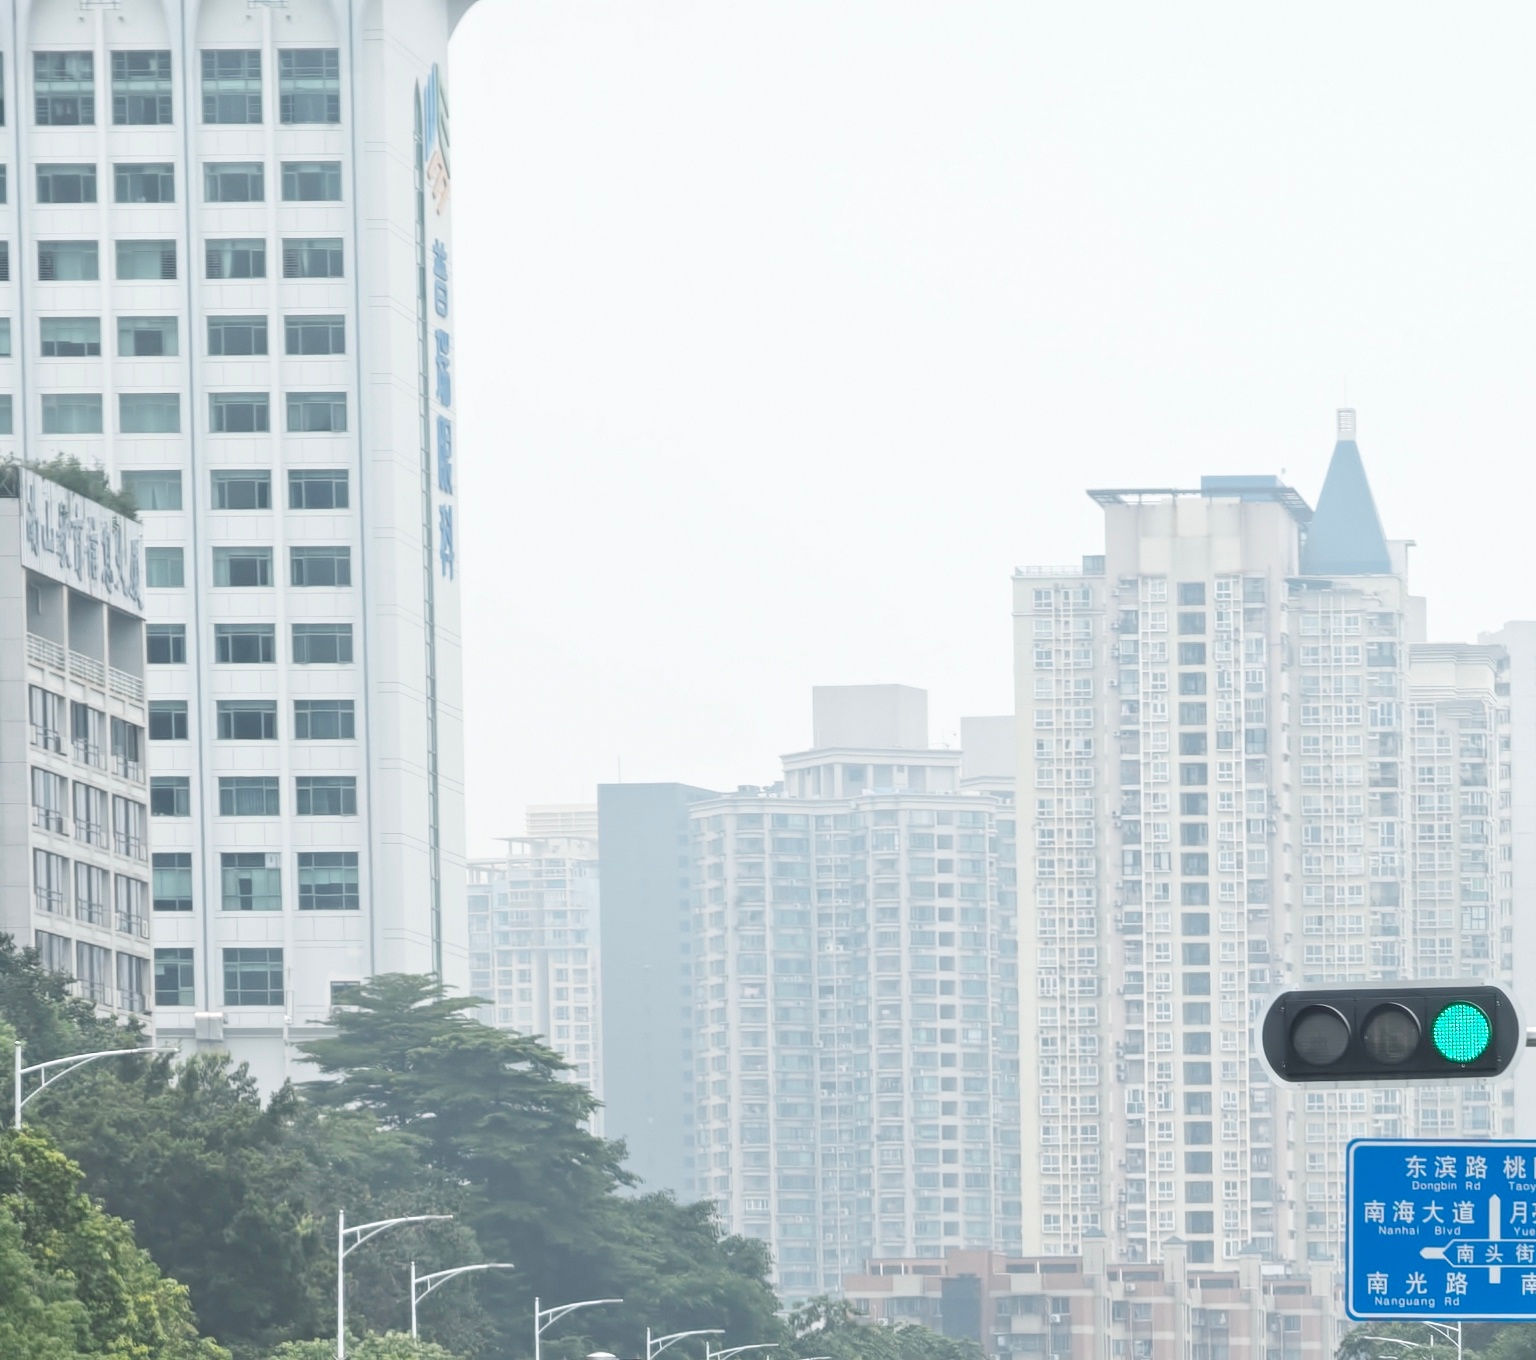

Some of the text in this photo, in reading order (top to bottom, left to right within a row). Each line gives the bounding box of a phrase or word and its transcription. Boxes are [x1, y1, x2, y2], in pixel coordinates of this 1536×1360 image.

[1404, 1155, 1488, 1179] 东滨路
[1412, 1181, 1457, 1193] Dongbin
[1465, 1181, 1481, 1191] Rd
[1363, 1200, 1475, 1225] 南海大道
[1378, 1225, 1461, 1236] Nanhai Blvd
[1457, 1243, 1535, 1264] 南头街
[1366, 1271, 1468, 1295] 南光路
[1374, 1297, 1460, 1308] Nanguang Rd
